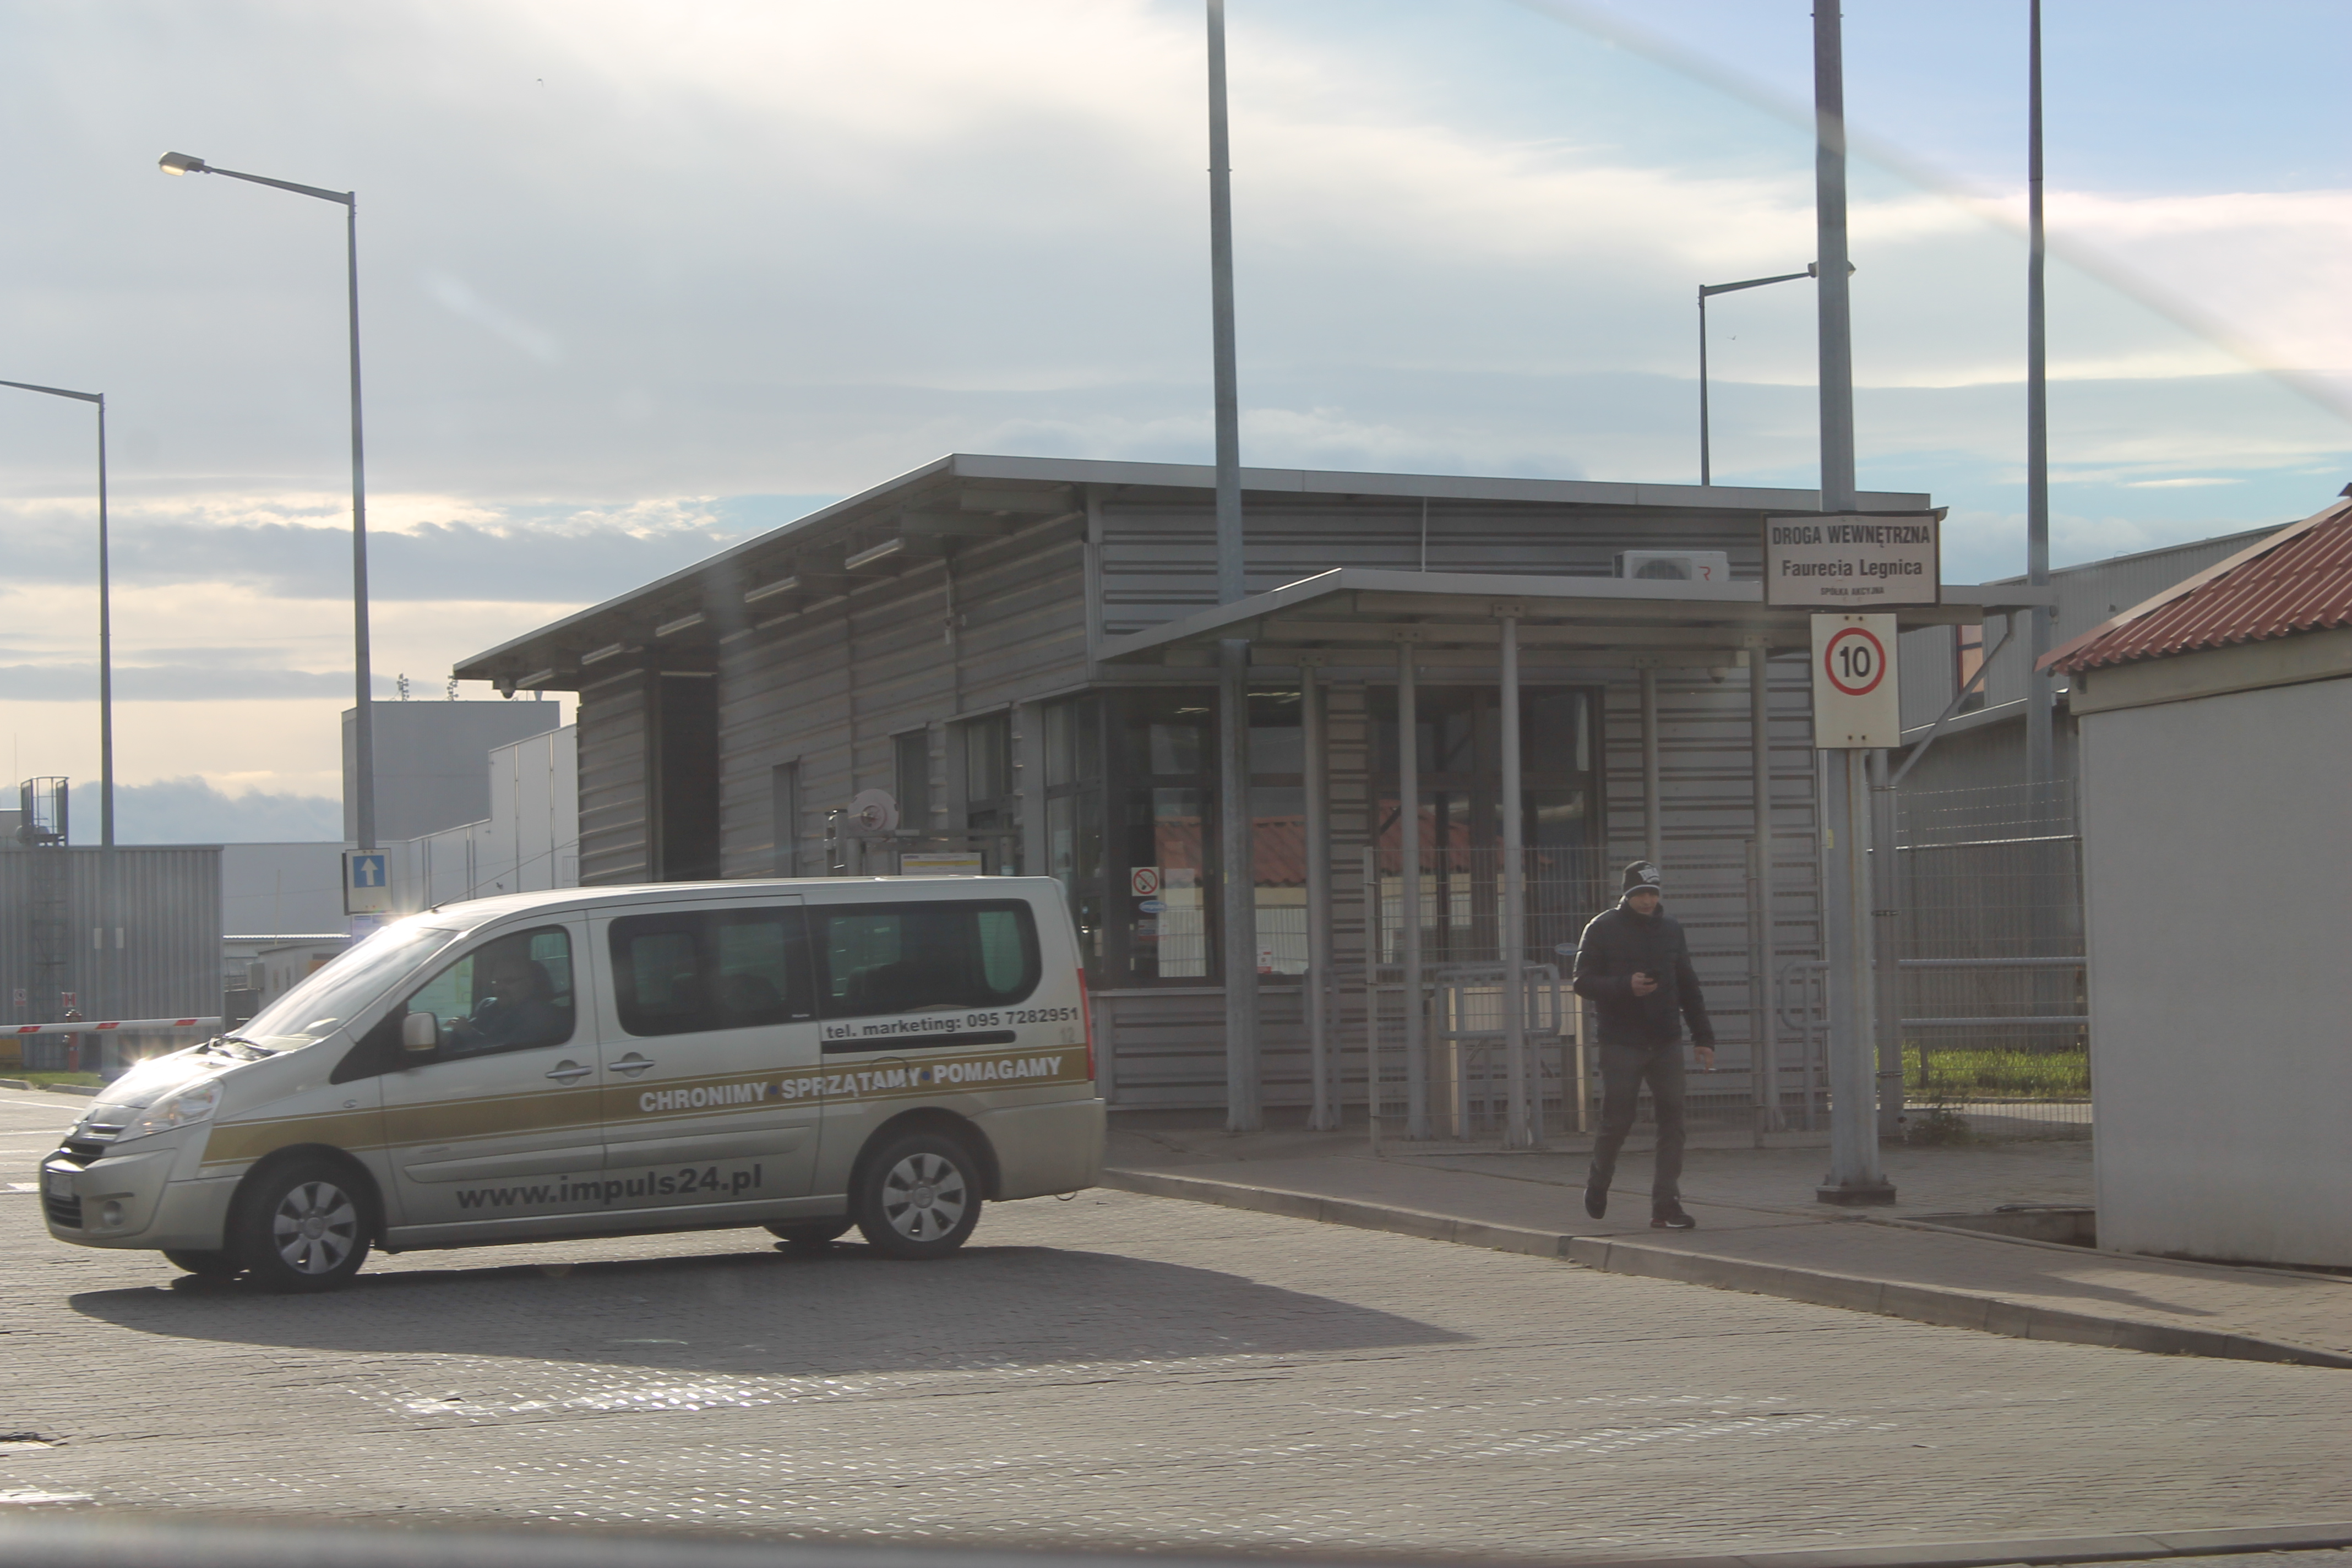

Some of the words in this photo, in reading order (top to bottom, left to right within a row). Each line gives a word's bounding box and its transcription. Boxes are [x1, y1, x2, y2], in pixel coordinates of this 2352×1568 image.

[1772, 526, 1822, 546] DROGA
[1827, 525, 1931, 548] WEWNĘTRZNA
[1782, 559, 1853, 576] Faurecia
[1859, 558, 1923, 579] Legnica
[1820, 586, 1849, 596] SPÓŁKA
[1851, 586, 1885, 596] AKCYJNA
[1839, 646, 1871, 678] 10
[826, 1024, 857, 1039] tel.
[862, 1016, 962, 1036] marketing:
[966, 1013, 1000, 1027] 095
[1006, 1007, 1079, 1025] 7282951
[640, 1081, 769, 1112] CHRONIMY
[781, 1066, 923, 1099] SPRZĄTAMY
[933, 1056, 1063, 1084] POMAGAMY
[456, 1163, 762, 1209] www.impuls24.pl
